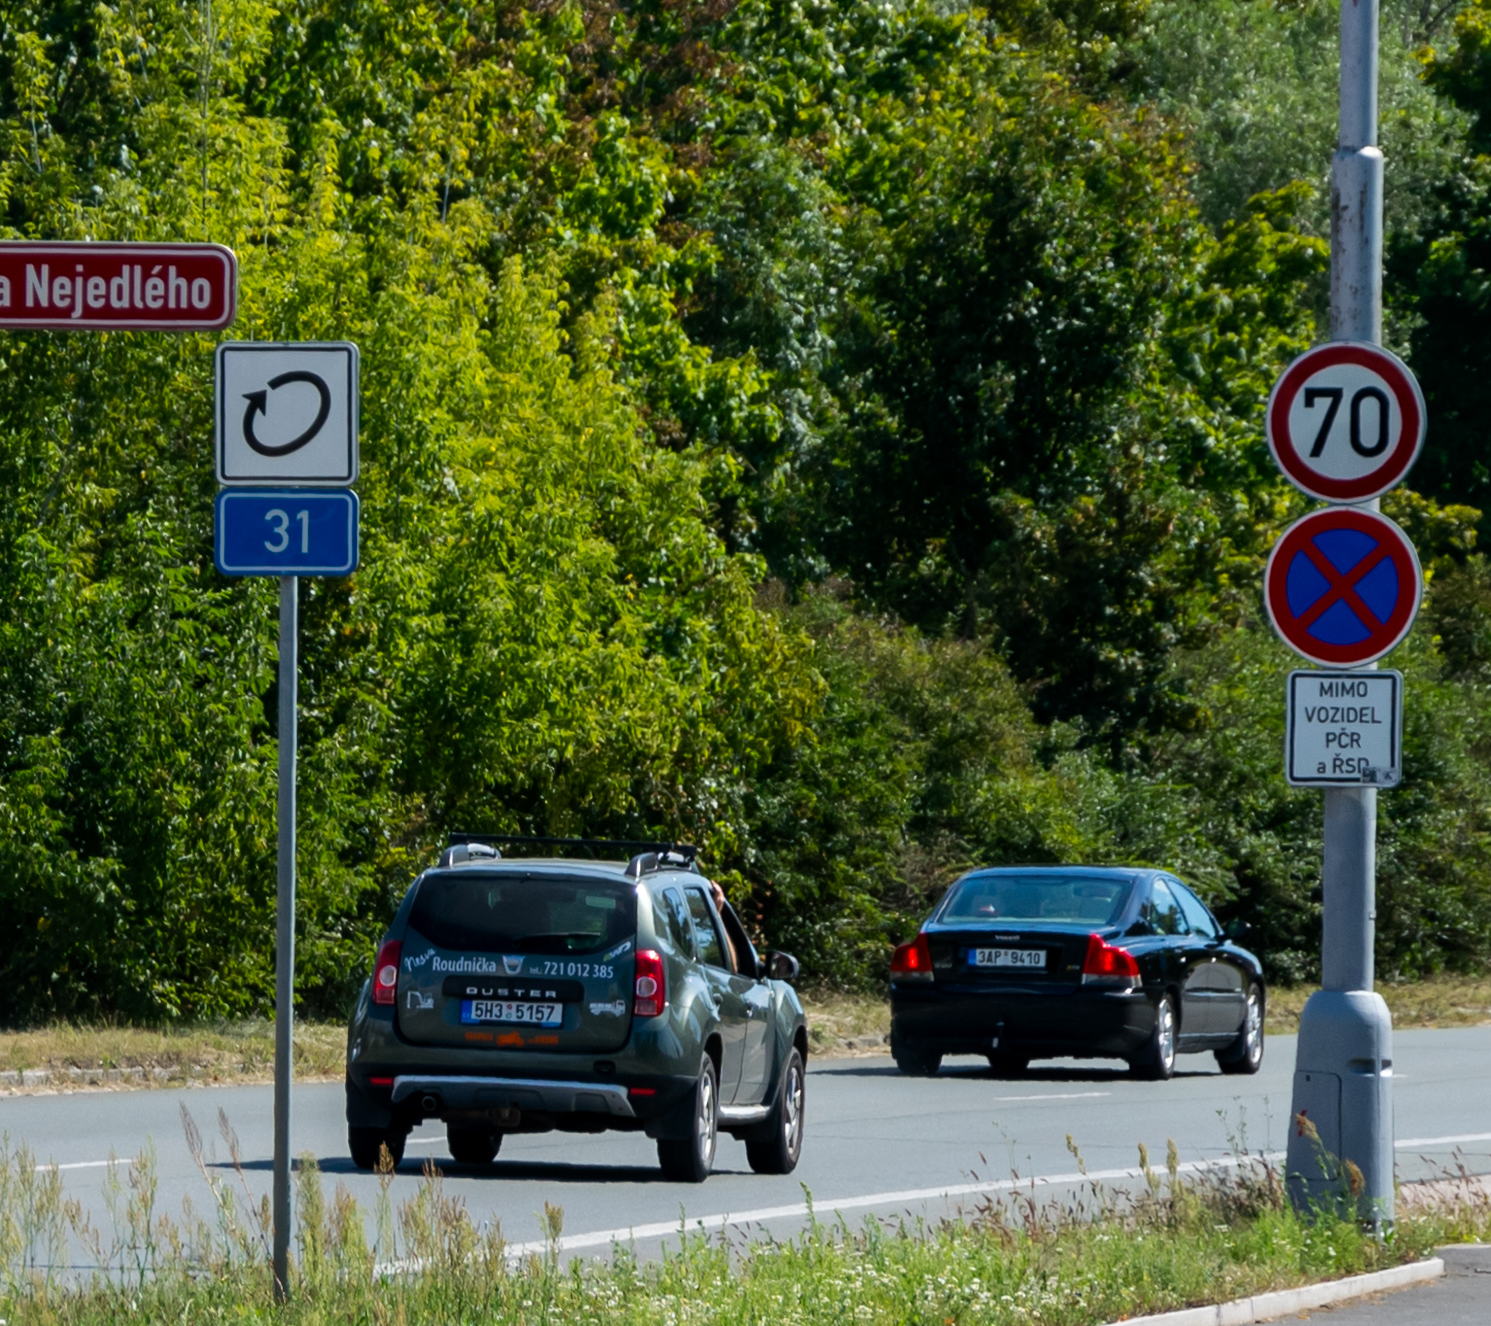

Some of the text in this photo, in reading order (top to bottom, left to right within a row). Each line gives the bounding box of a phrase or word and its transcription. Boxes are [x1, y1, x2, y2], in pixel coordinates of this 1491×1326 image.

[24, 263, 212, 320] Nejedlého
[1303, 385, 1391, 458] 70
[263, 508, 310, 554] 31
[1319, 681, 1368, 698] MIMO
[1304, 706, 1383, 724] VOZIDEL
[1325, 727, 1362, 749] PČR
[1316, 761, 1327, 774] a
[432, 956, 497, 973] Roudnička
[543, 961, 565, 976] 721
[567, 963, 590, 977] 012
[592, 964, 614, 979] 385
[978, 951, 1041, 965] 3AP 9410
[466, 986, 557, 998] DUSTER
[474, 1002, 556, 1022] 5H3 5157
